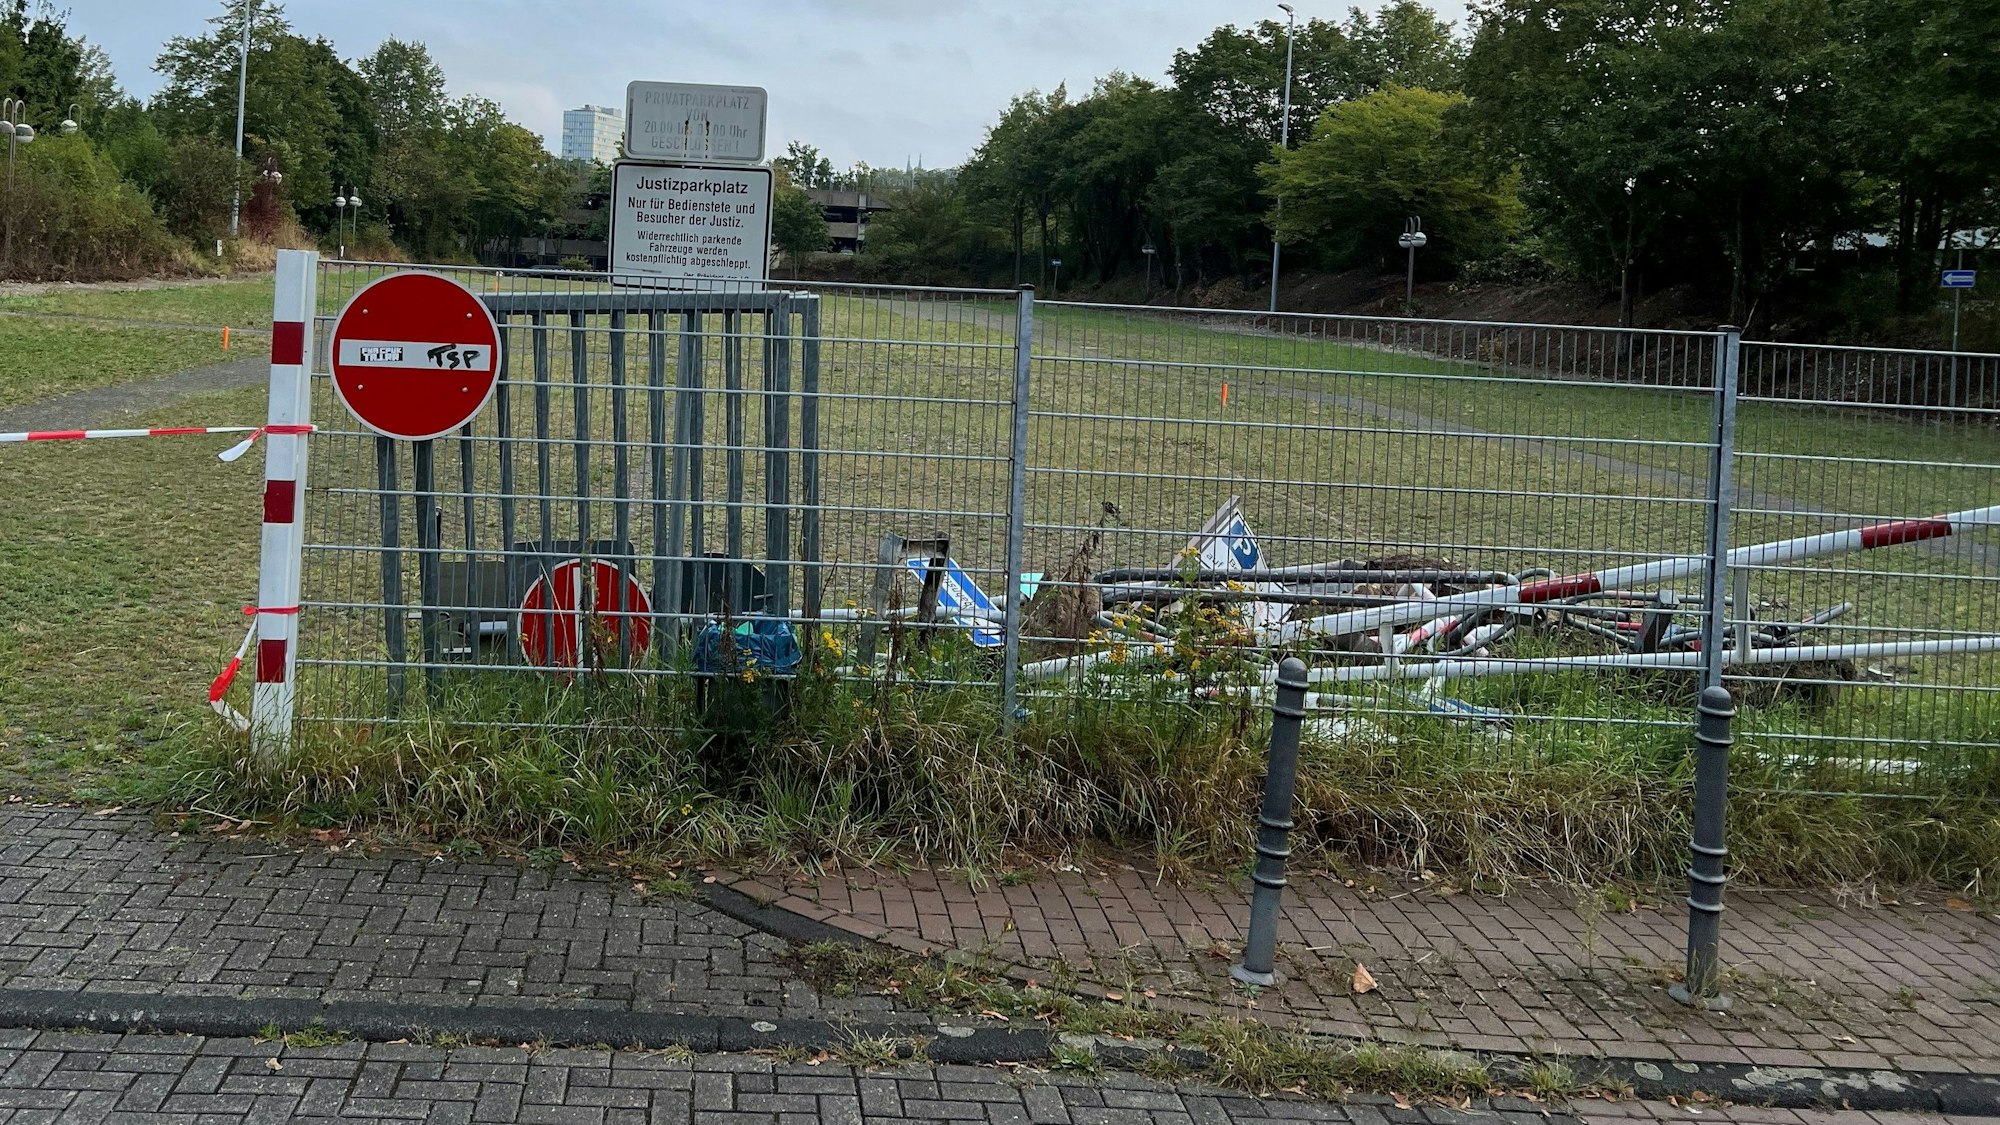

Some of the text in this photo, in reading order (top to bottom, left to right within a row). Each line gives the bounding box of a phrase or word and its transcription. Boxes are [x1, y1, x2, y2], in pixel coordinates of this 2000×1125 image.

[645, 91, 750, 110] PRIVATPARKPLATZ
[686, 109, 708, 122] VON
[677, 122, 693, 136] bs
[729, 125, 748, 139] Uhr
[651, 135, 732, 152] GESCLOSEN
[636, 176, 748, 196] Justizparkplatz
[628, 197, 755, 215] Nur für Bedienstete und
[636, 211, 744, 228] Besucher der Justiz.
[637, 230, 742, 246] Widerrechtlich parkende
[649, 242, 728, 256] Fahrzeuge werden
[626, 252, 751, 270] kostenpflichtig abgeschleppt.
[427, 344, 480, 370] TSP
